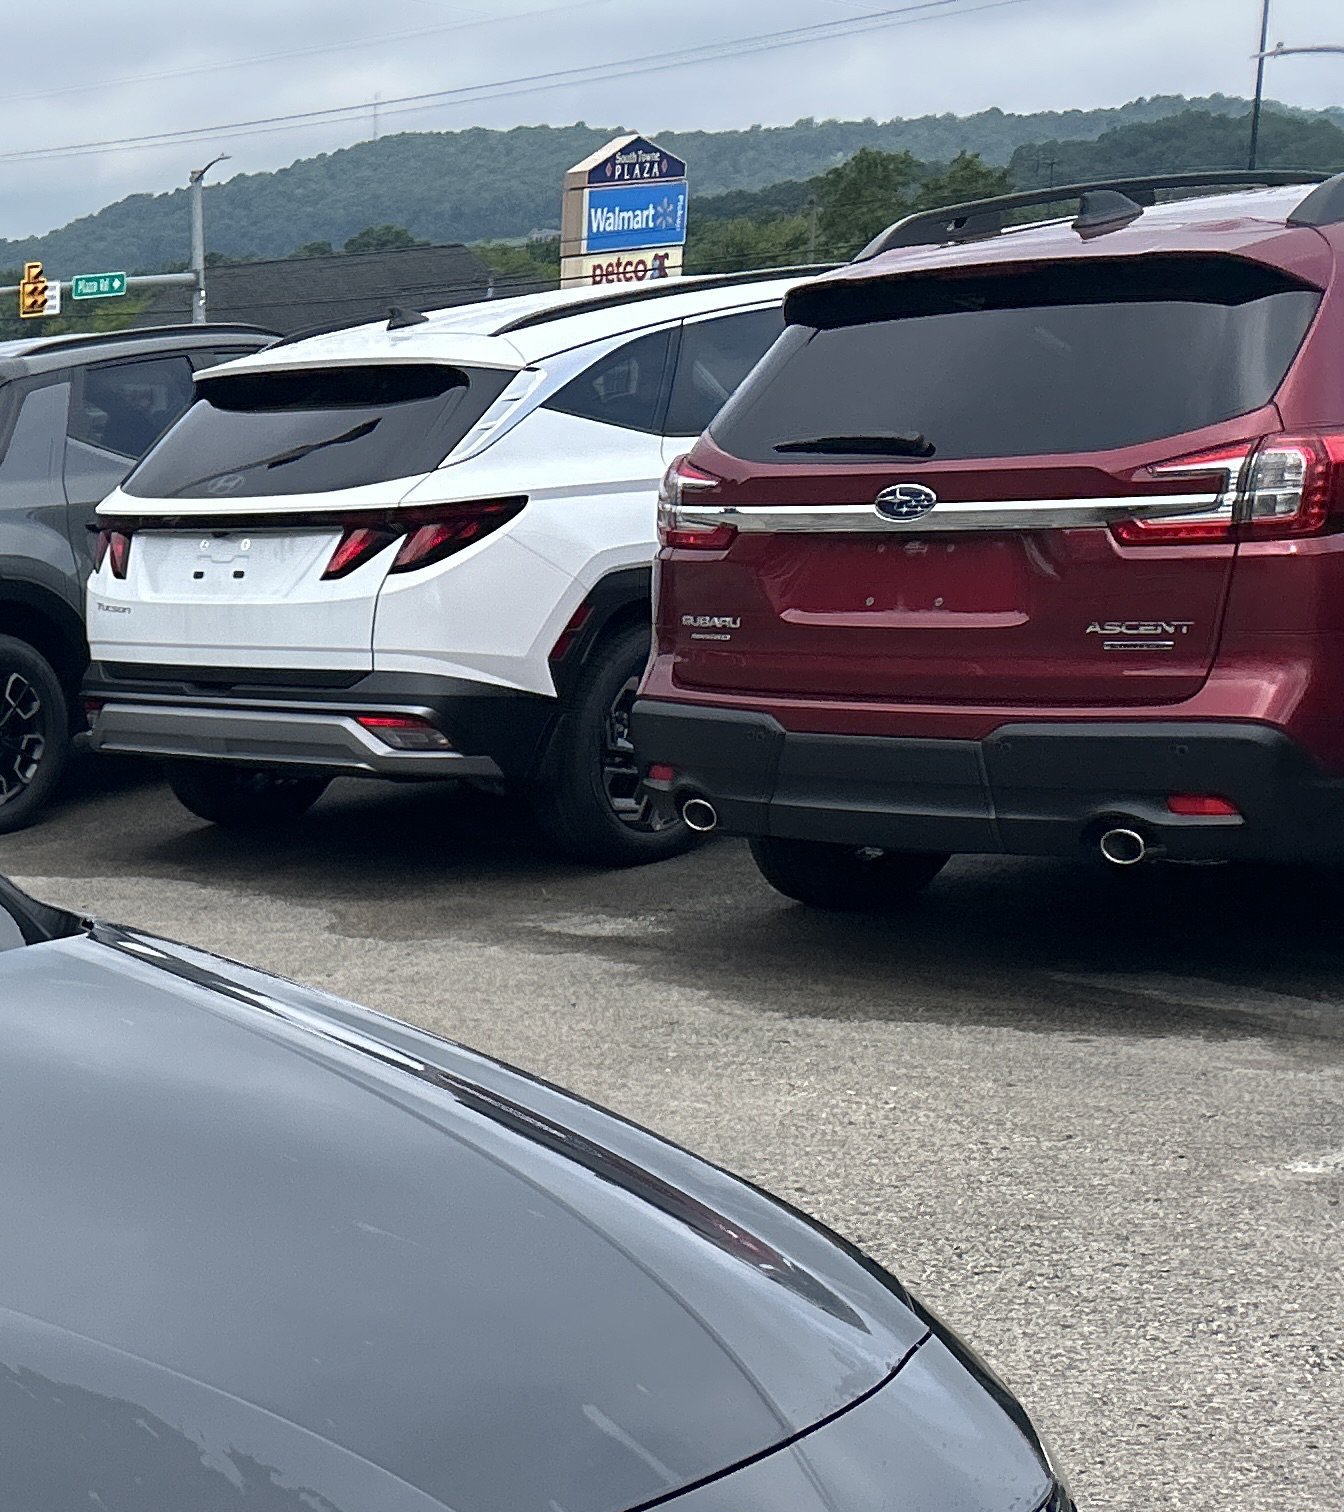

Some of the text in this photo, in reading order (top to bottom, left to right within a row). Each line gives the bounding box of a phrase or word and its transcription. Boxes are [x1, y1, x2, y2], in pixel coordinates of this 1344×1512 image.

[615, 163, 660, 180] PLAZA
[590, 203, 655, 233] Walmart
[592, 257, 648, 286] petco
[97, 603, 131, 614] Tucson
[682, 615, 741, 628] SUBARU
[1086, 622, 1194, 634] ASCENT
